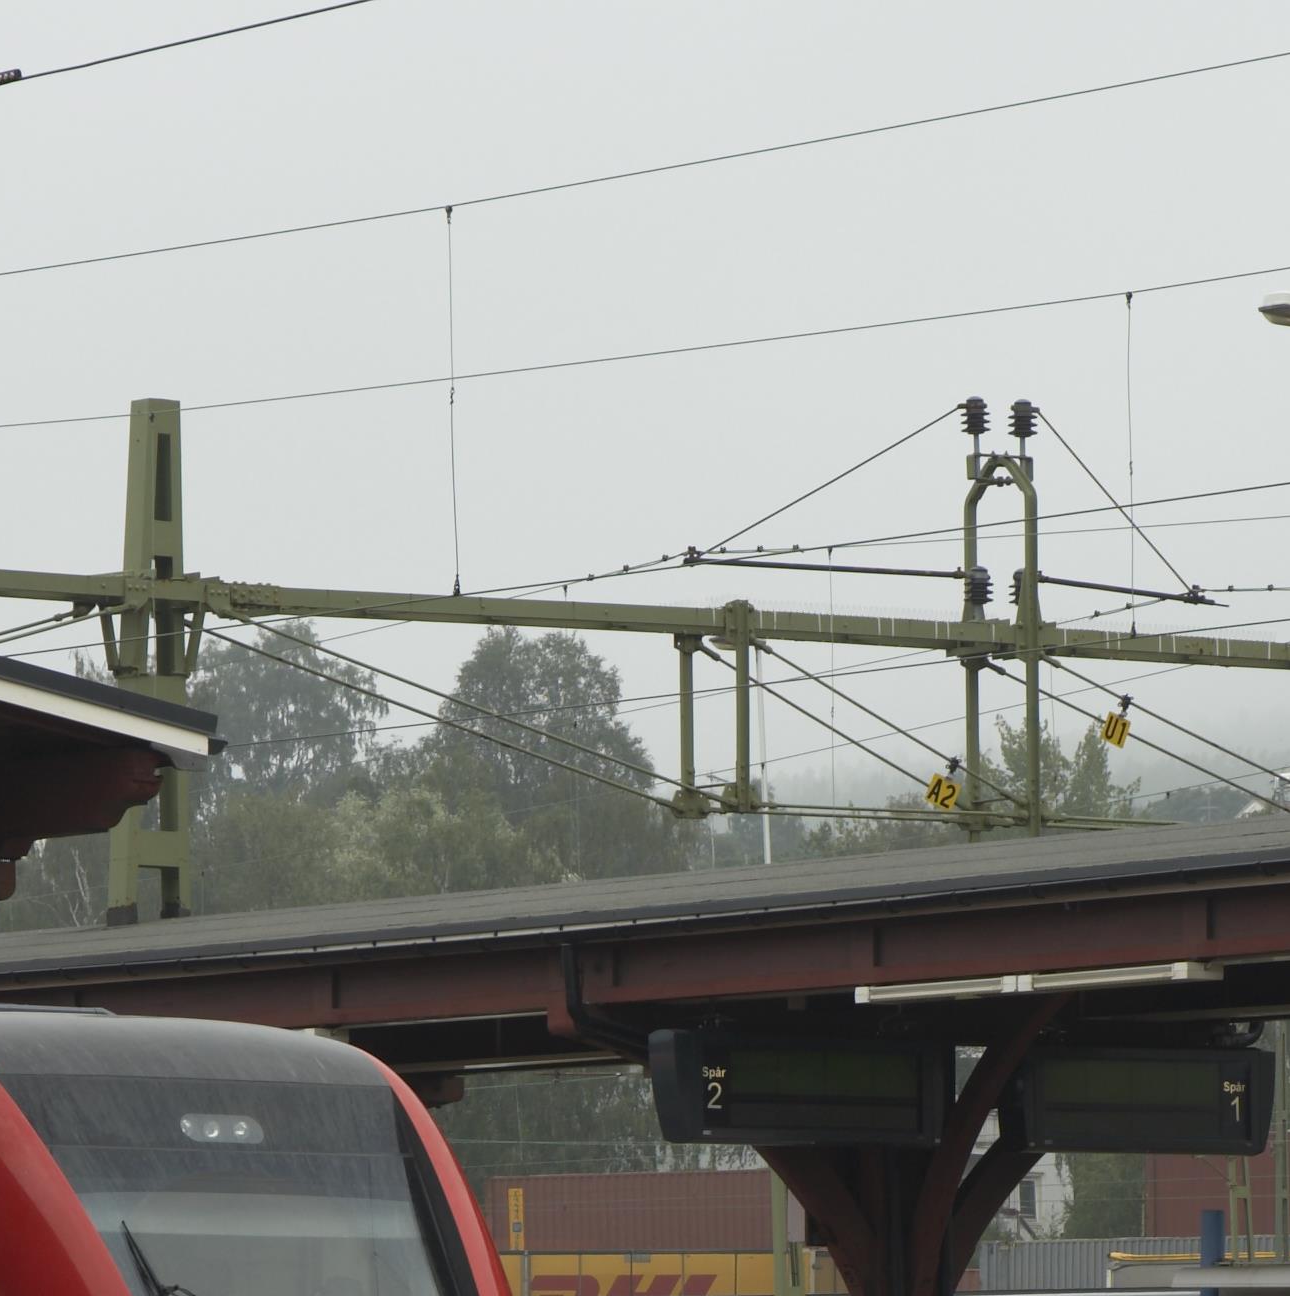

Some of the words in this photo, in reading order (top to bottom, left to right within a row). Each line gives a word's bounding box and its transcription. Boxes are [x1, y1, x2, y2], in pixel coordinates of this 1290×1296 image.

[1104, 716, 1127, 745] U1
[927, 778, 956, 809] A2
[702, 1066, 727, 1080] Spår
[707, 1082, 723, 1109] 2
[1223, 1080, 1246, 1094] Spår
[1230, 1095, 1240, 1122] 1
